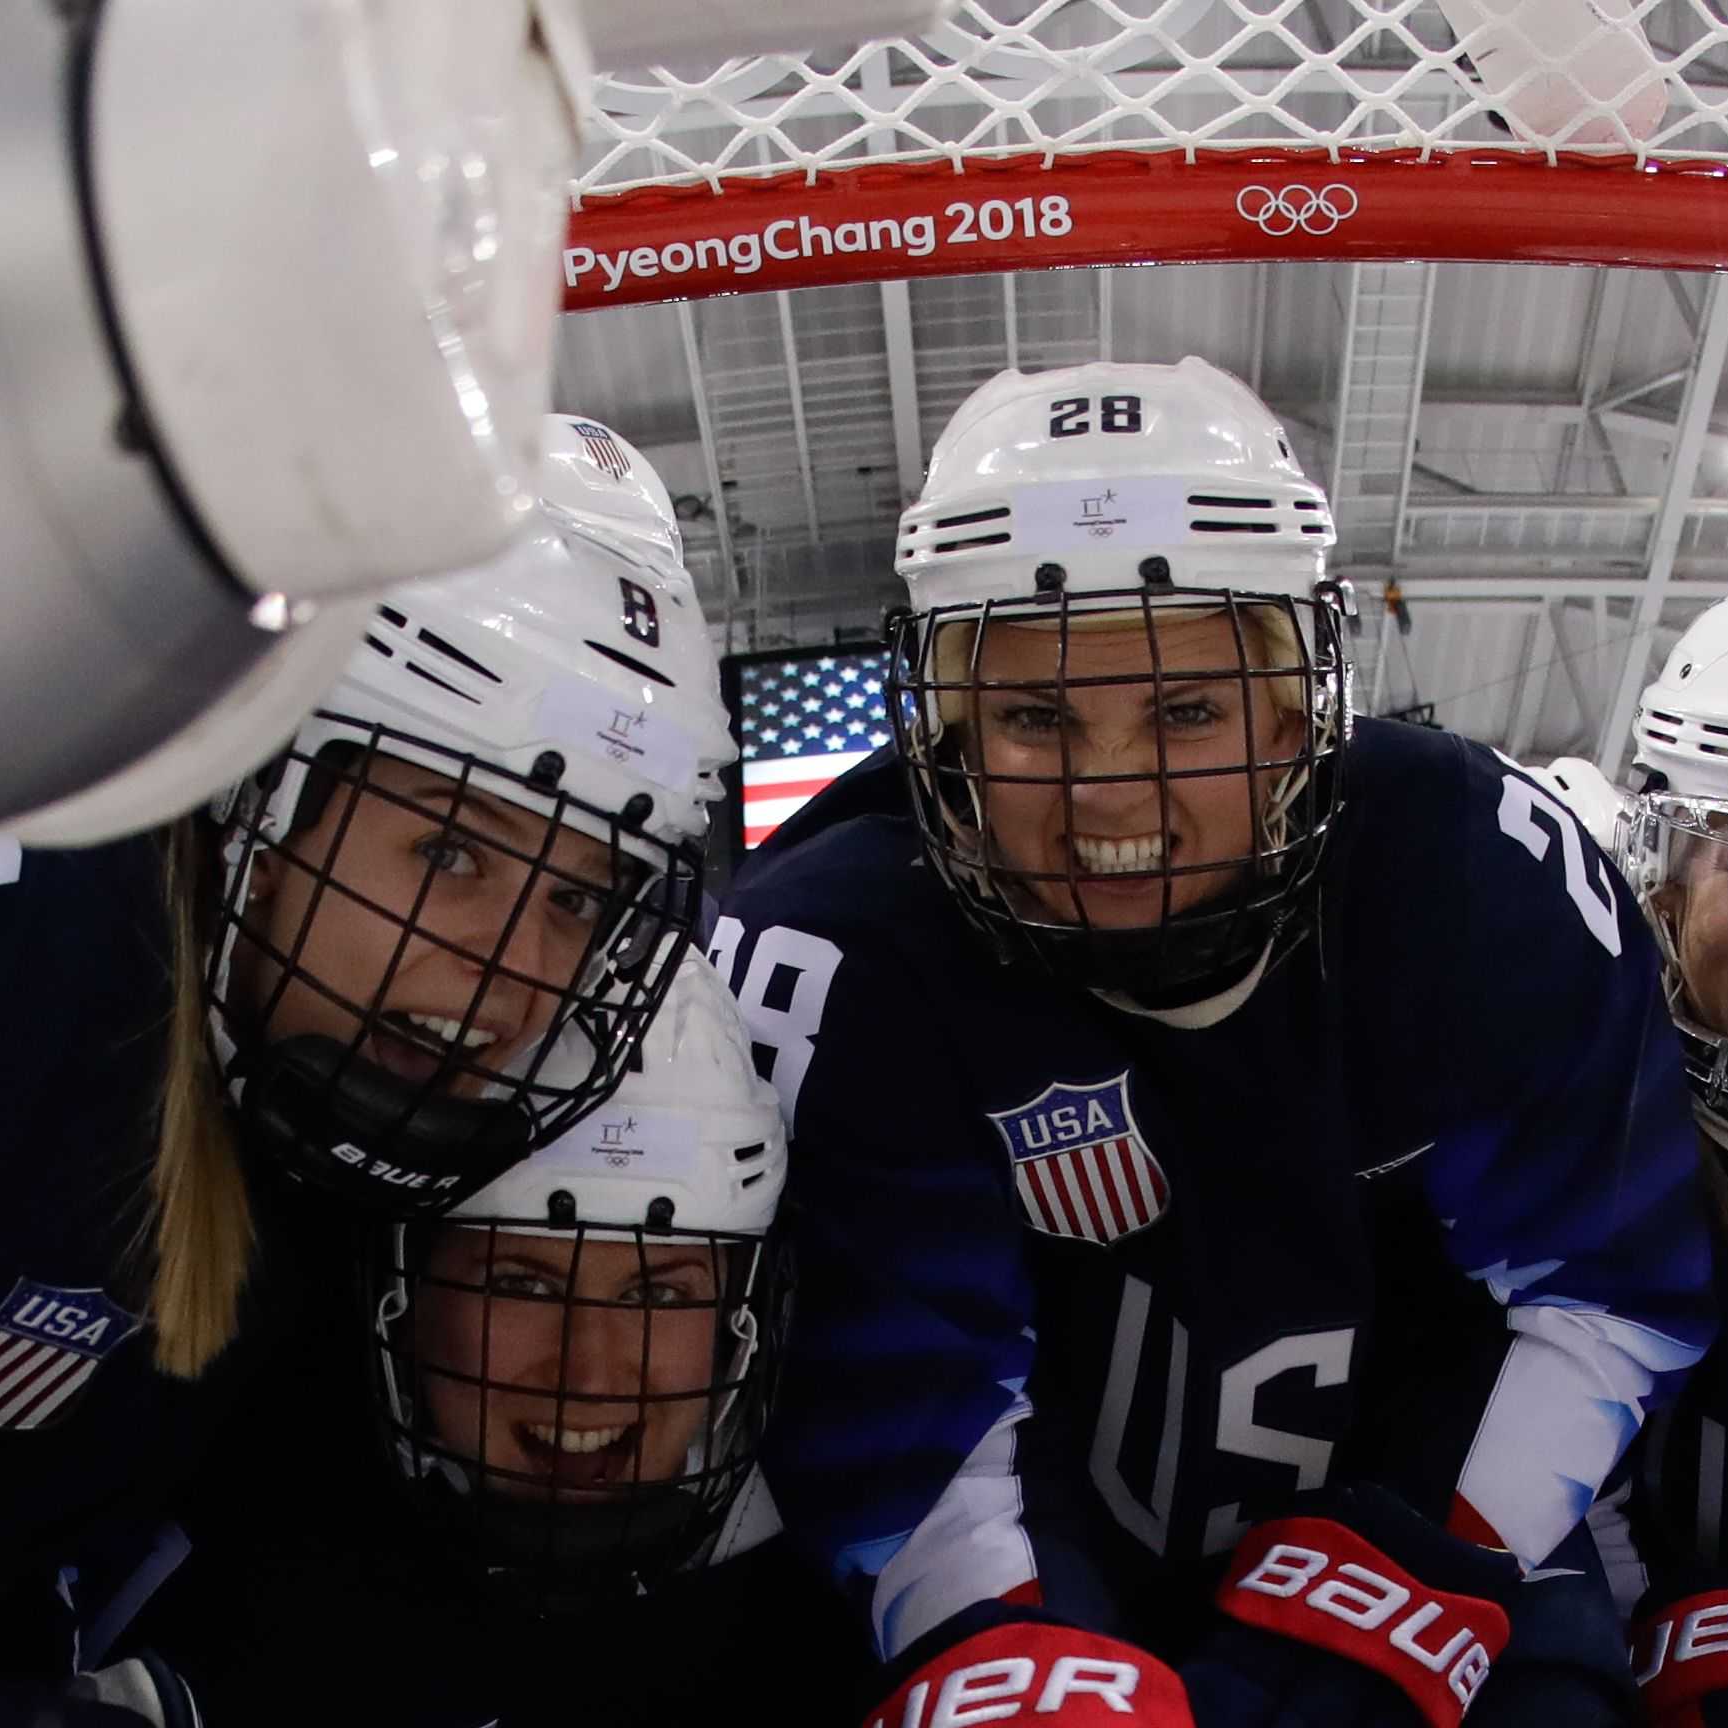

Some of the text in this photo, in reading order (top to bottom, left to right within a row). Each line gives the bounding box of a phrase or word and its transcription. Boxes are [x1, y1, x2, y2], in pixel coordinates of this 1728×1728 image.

[562, 195, 1074, 293] PyeongChang 2018
[1049, 395, 1142, 438] 28
[618, 576, 660, 648] 8
[1019, 1096, 1115, 1151] USA
[9, 1291, 113, 1349] USA
[1238, 1543, 1493, 1720] BAUE
